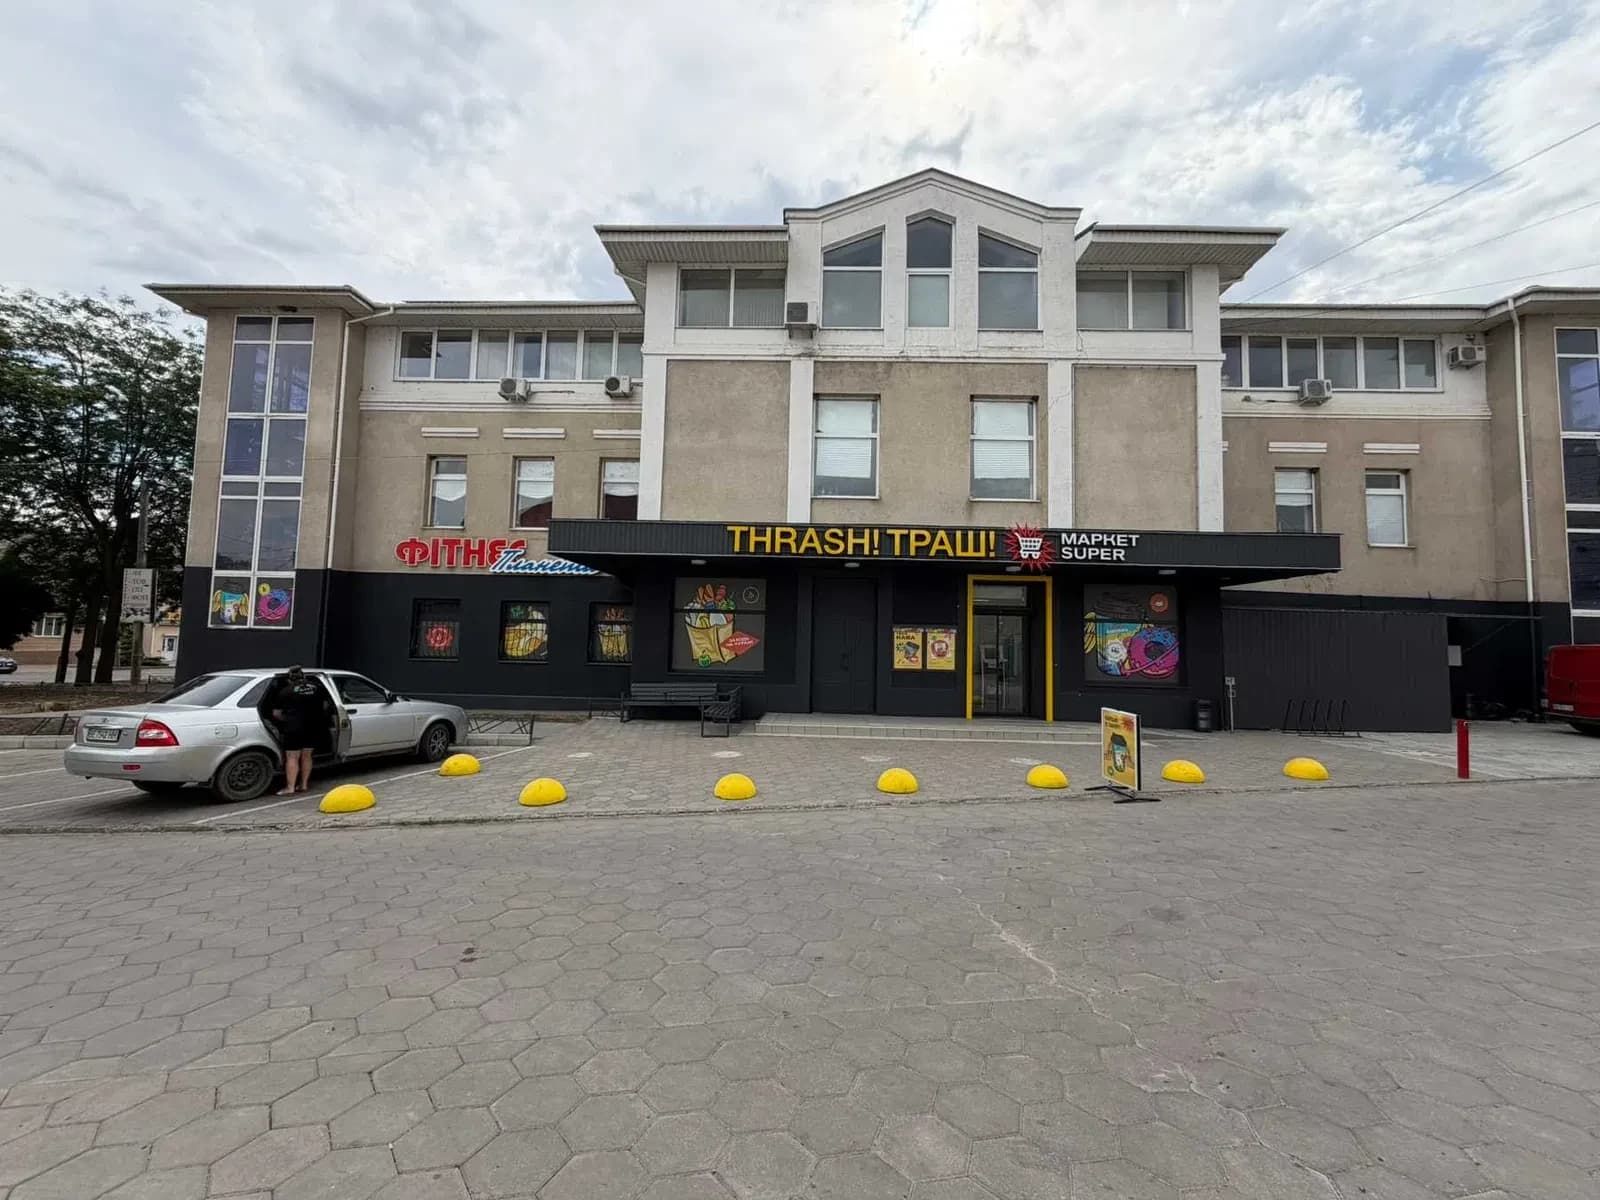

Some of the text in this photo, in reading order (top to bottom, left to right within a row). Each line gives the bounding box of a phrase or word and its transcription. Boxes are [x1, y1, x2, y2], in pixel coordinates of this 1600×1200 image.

[727, 525, 996, 558] THRASH! ТРАШ!
[1061, 546, 1126, 561] SUPER
